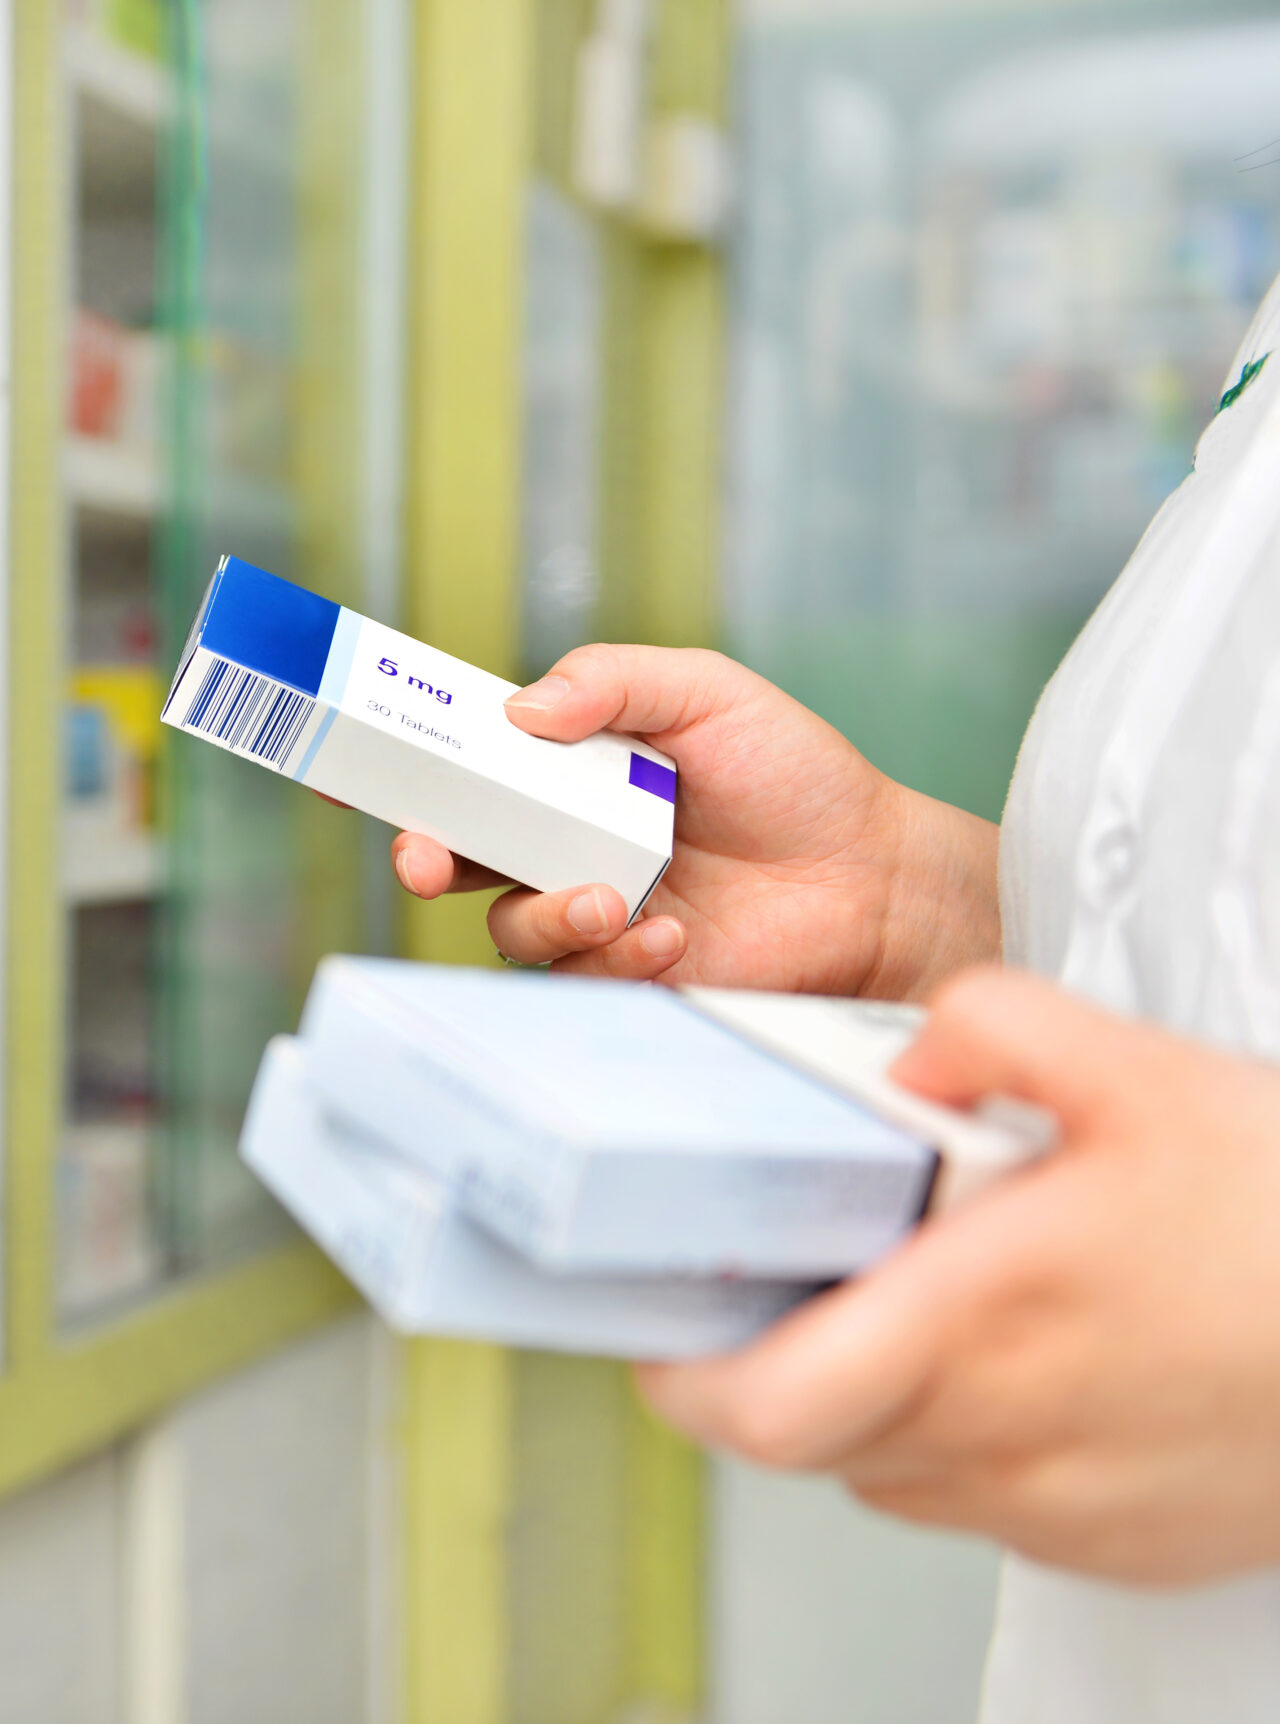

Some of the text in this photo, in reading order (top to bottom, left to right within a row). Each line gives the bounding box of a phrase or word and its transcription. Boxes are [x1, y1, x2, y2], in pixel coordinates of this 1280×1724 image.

[377, 657, 453, 705] 5 mg
[367, 700, 462, 749] 30 Tablets
